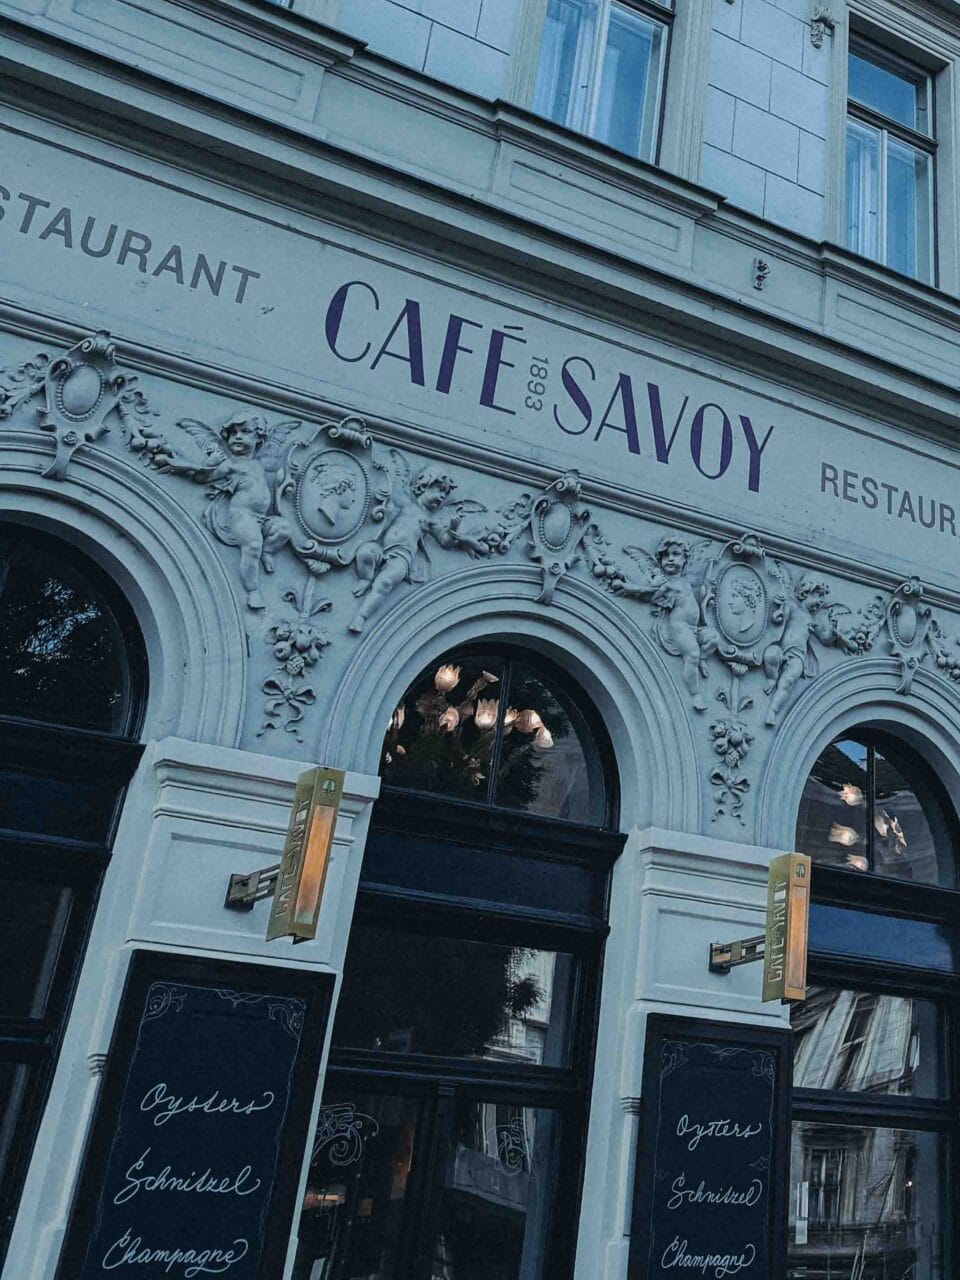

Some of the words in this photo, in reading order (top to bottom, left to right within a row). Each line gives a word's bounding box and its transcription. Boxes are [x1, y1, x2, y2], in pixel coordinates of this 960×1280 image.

[324, 280, 528, 416] CAFÉ
[553, 355, 775, 494] SAVOY
[525, 356, 549, 411] 1893
[140, 1083, 275, 1126] Oysters
[676, 1114, 762, 1151] Oysters
[114, 1147, 262, 1205] Schnitzel
[667, 1172, 763, 1210] Schnitzel
[102, 1227, 249, 1278] Champagne
[661, 1235, 756, 1279] Champagne
